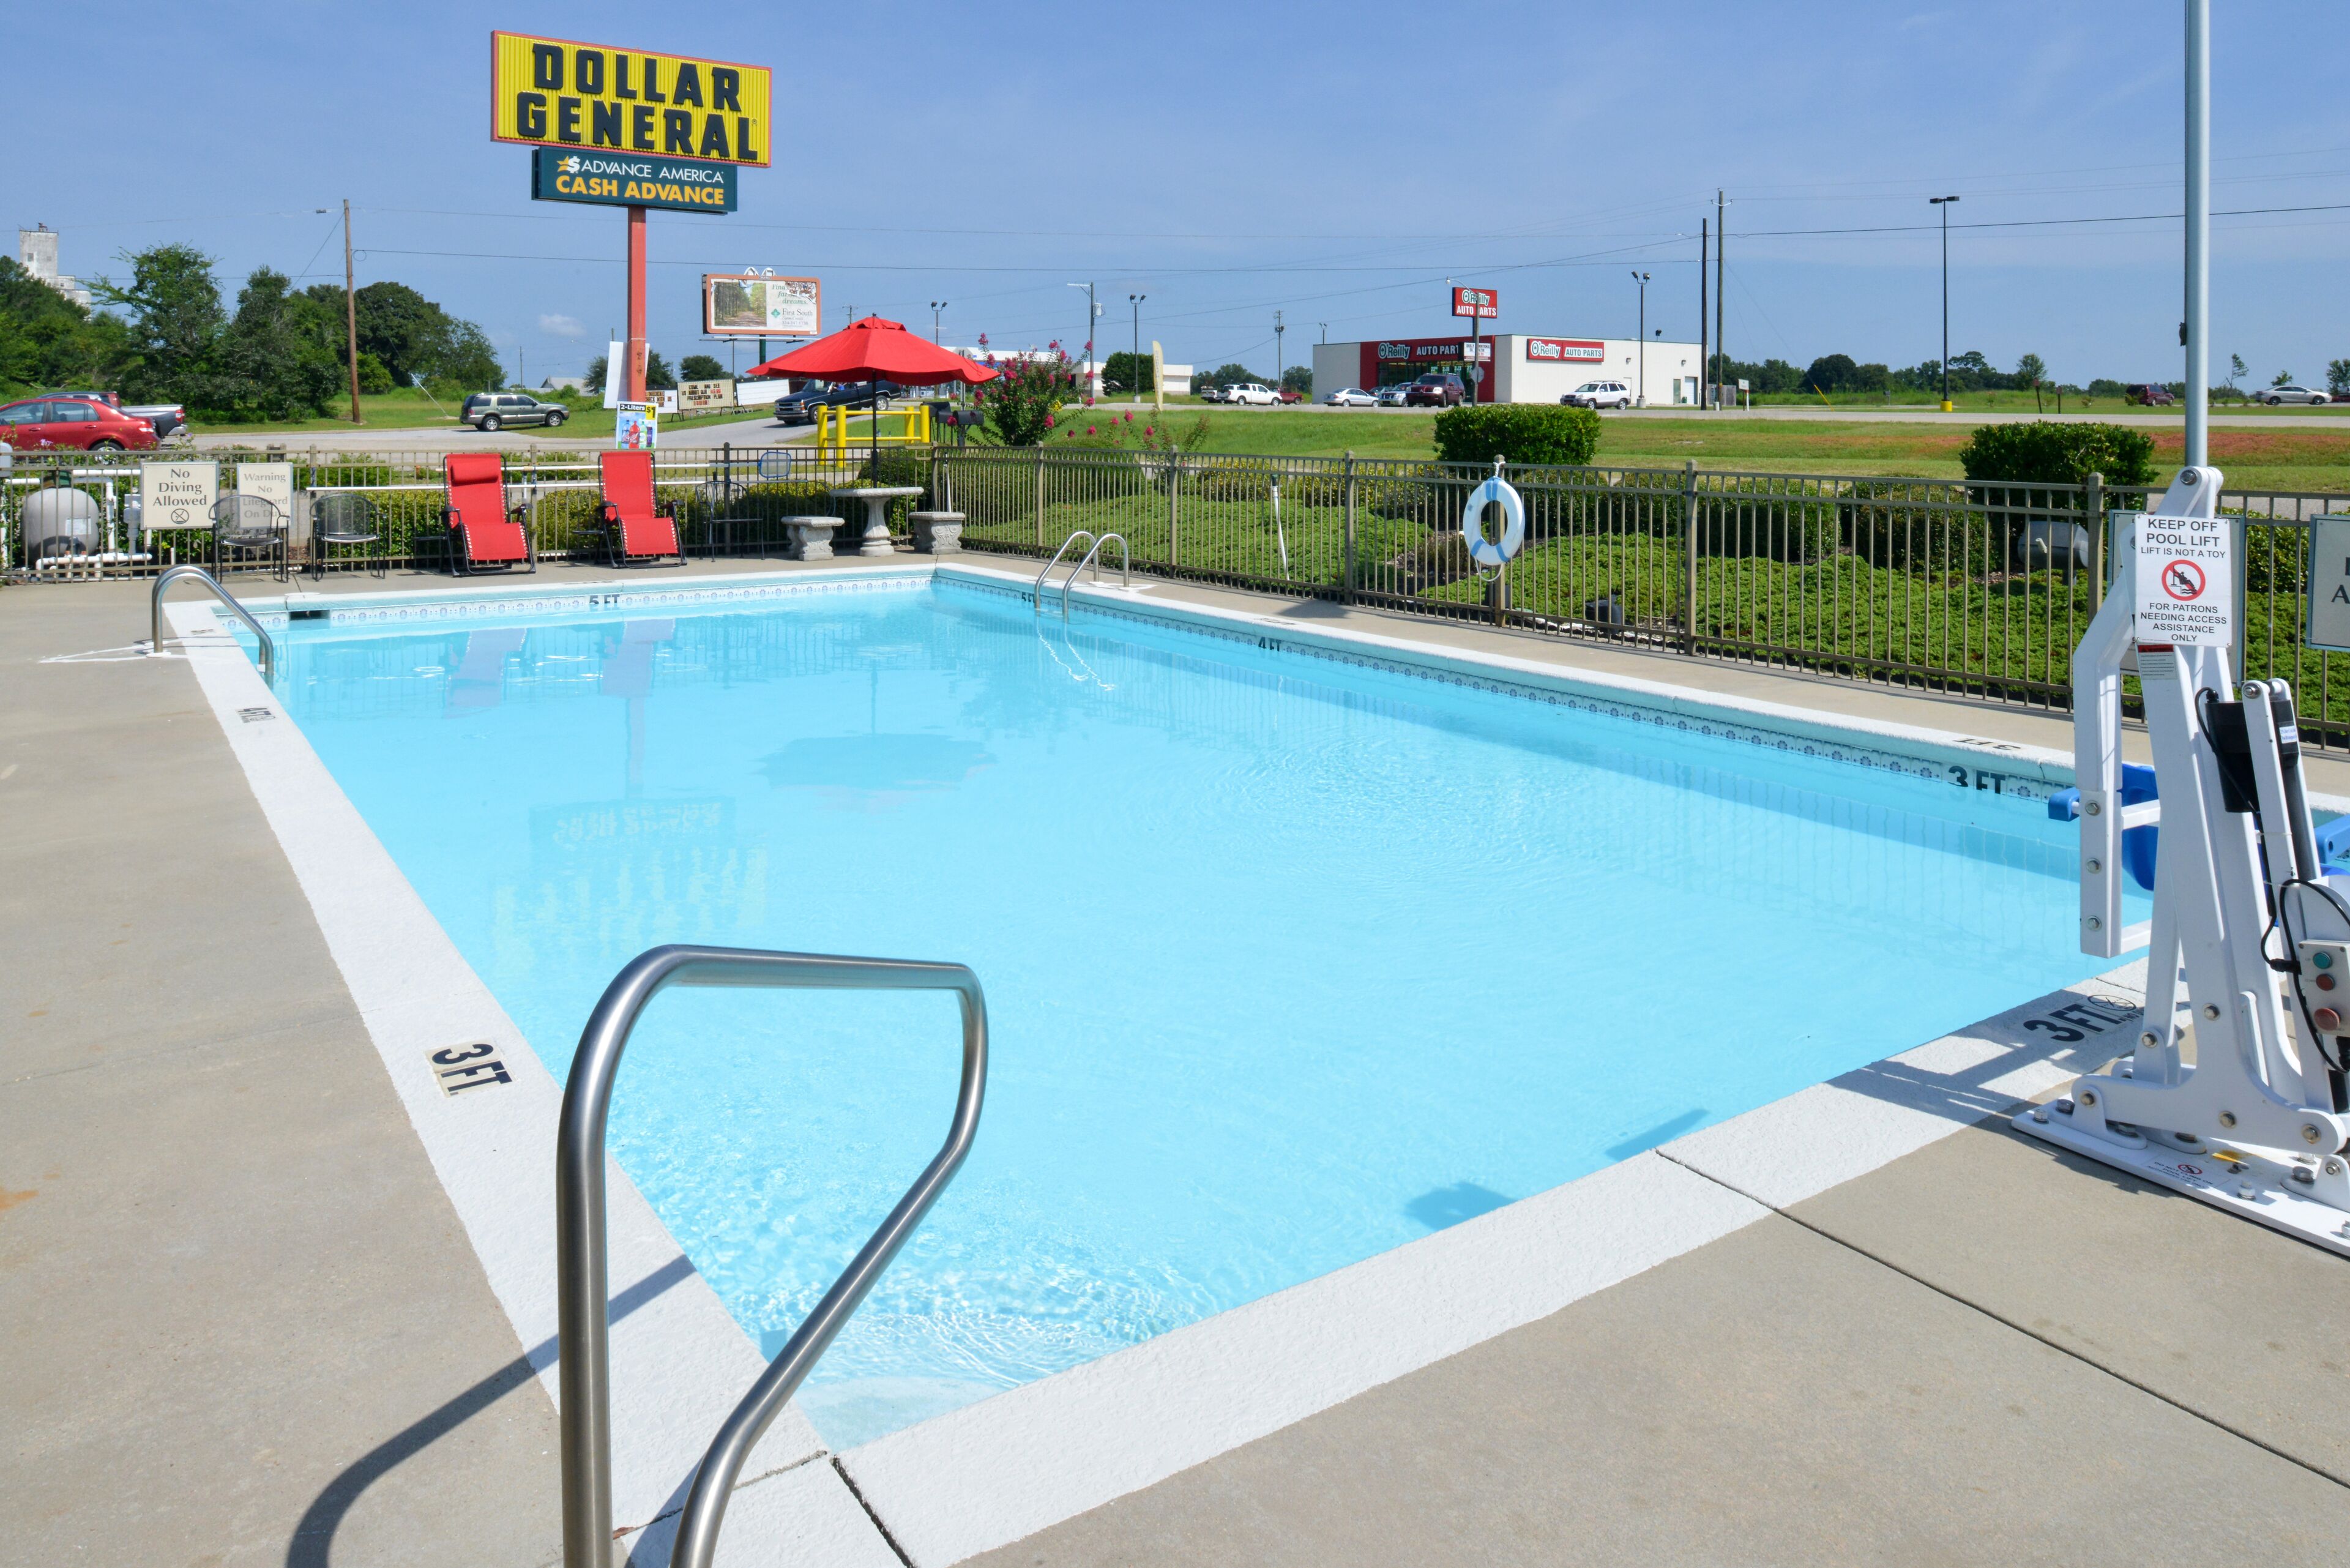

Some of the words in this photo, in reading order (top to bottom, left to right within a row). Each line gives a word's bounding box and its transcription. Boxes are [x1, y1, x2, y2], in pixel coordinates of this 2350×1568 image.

[532, 43, 741, 111] DOLLAR
[517, 91, 757, 160] GENERAL
[581, 159, 652, 178] ADVANCE
[659, 166, 724, 184] AMERICA
[556, 175, 617, 196] CASH
[624, 181, 724, 204] ADVANCE
[1462, 289, 1490, 306] O'Rilly
[1457, 306, 1474, 315] AUTO
[1479, 307, 1496, 316] ARTS
[1379, 343, 1410, 359] O'Reilly
[1417, 346, 1438, 355] AUTO
[1440, 345, 1458, 354] PART
[1531, 342, 1560, 357] O'Reilly
[646, 406, 656, 418] $1
[171, 468, 190, 479] No
[244, 472, 286, 482] Warning
[159, 482, 202, 495] Diving
[153, 496, 207, 506] Allowed
[243, 496, 288, 507] Lifegard
[2148, 519, 2185, 530] KEEP
[2191, 521, 2218, 531] OFF
[2147, 533, 2186, 545] POOL
[2191, 536, 2220, 547] LIFT
[589, 595, 599, 604] 5
[604, 594, 620, 604] FT
[2173, 604, 2218, 613] PATRONS
[2141, 612, 2185, 622] NEEDING
[2188, 614, 2227, 624] ACCESS
[2152, 623, 2215, 633] ASSISTANCE
[1258, 637, 1266, 649] 4
[1269, 638, 1281, 652] FT
[1949, 766, 1968, 788] 3
[1976, 770, 2006, 794] FT
